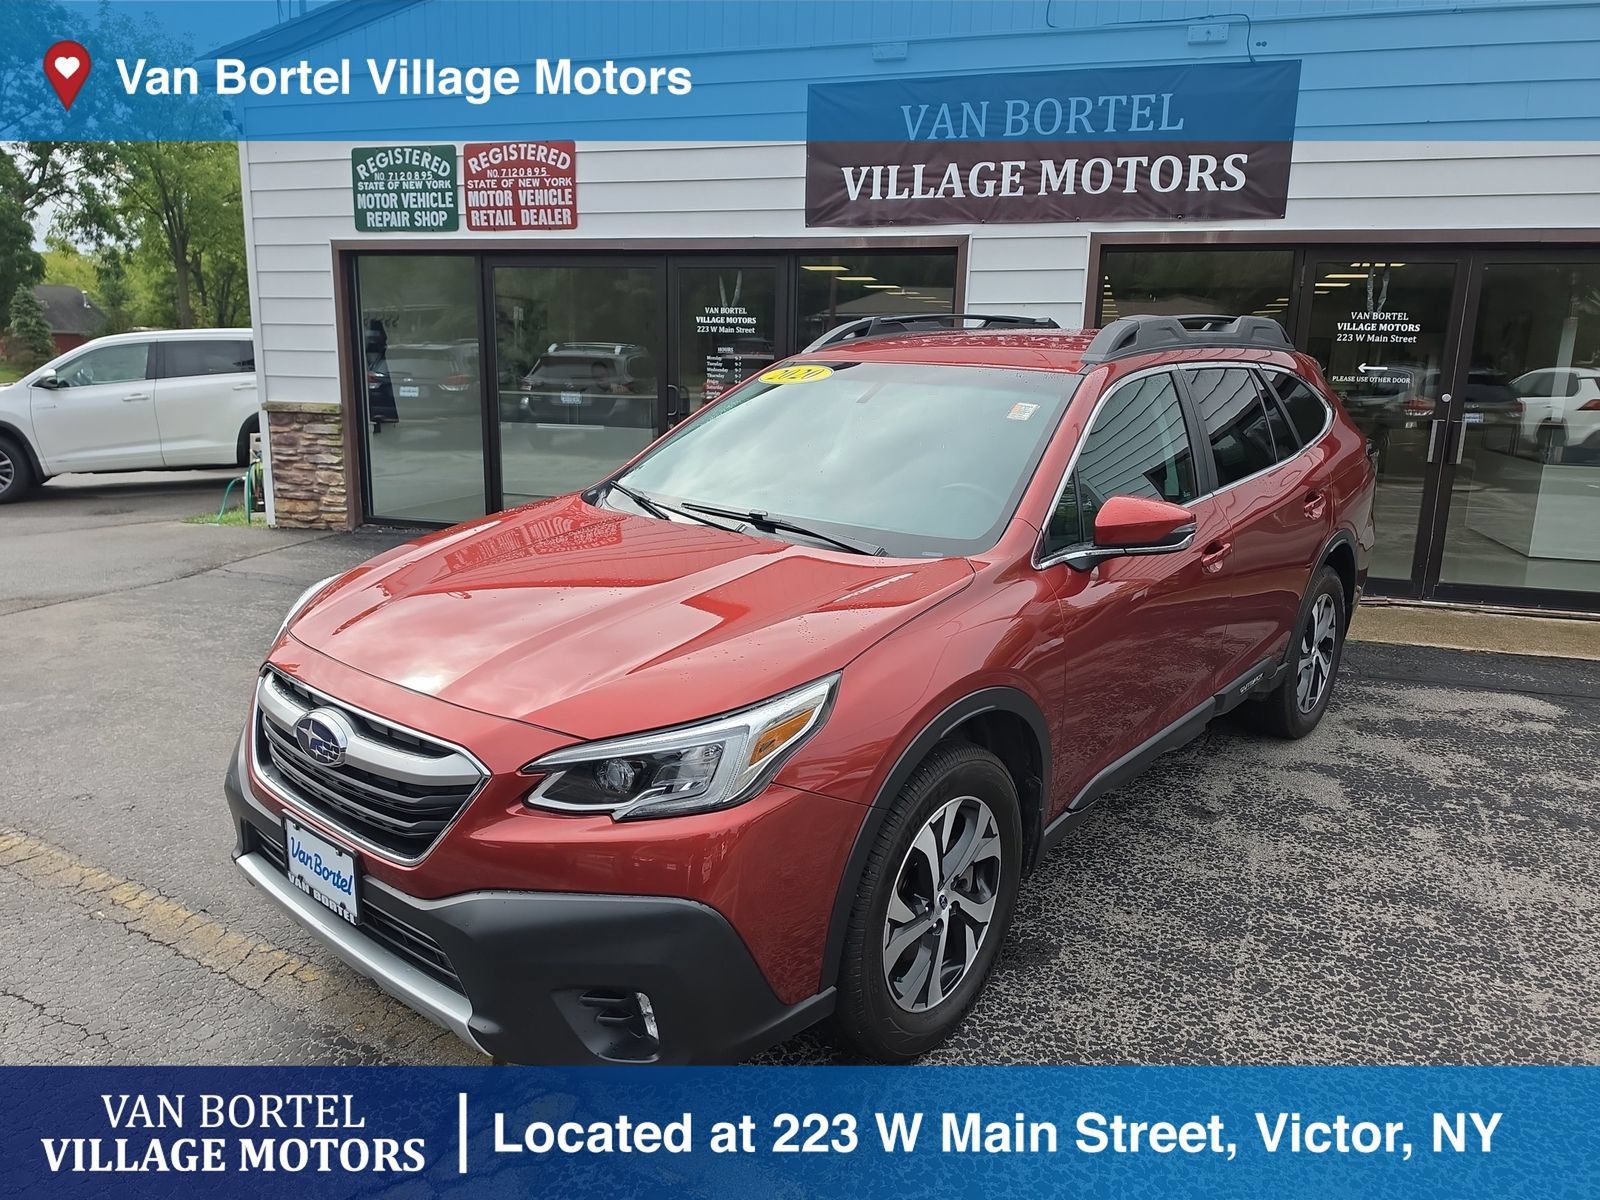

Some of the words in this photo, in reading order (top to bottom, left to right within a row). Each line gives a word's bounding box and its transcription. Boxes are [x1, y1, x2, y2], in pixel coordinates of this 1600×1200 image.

[900, 101, 990, 141] VAN
[1003, 93, 1185, 137] BORTEL
[356, 148, 451, 180] REGISTERED
[467, 143, 571, 174] REGISTERED
[388, 171, 433, 180] 7120895
[501, 167, 547, 177] 7120895
[841, 160, 1027, 201] VILLAGE
[1037, 153, 1249, 196] MOTORS
[357, 181, 385, 190] STATE
[387, 181, 400, 190] OF
[402, 180, 423, 190] NEW
[425, 179, 452, 189] YORK
[467, 179, 497, 189] STATE
[501, 178, 515, 188] OF
[518, 178, 540, 187] NEW
[544, 177, 572, 187] YORK
[357, 192, 399, 209] MOTOR
[401, 191, 454, 209] VEHICLE
[467, 190, 513, 207] MOTOR
[518, 189, 573, 206] VEHICLE
[366, 211, 411, 227] REPAIR
[414, 210, 448, 227] SHOP
[471, 209, 517, 226] RETAIL
[521, 208, 572, 226] DEALER
[704, 306, 720, 314] VAN
[720, 306, 748, 314] BORTEL
[1351, 311, 1371, 320] VAN
[1372, 311, 1409, 321] BORTEL
[695, 316, 725, 324] VILLAGE
[726, 316, 757, 324] MOTORS
[696, 325, 710, 333] 223
[710, 325, 718, 333] W
[718, 325, 735, 333] Main
[735, 326, 756, 334] Street
[1337, 322, 1378, 331] VILLAGE
[1378, 323, 1421, 332] MOTORS
[1336, 333, 1354, 342] 223
[1355, 333, 1366, 342] W
[1366, 333, 1389, 342] Main
[1390, 334, 1417, 343] Street
[287, 870, 310, 895] VAN
[313, 888, 357, 926] BORTEL
